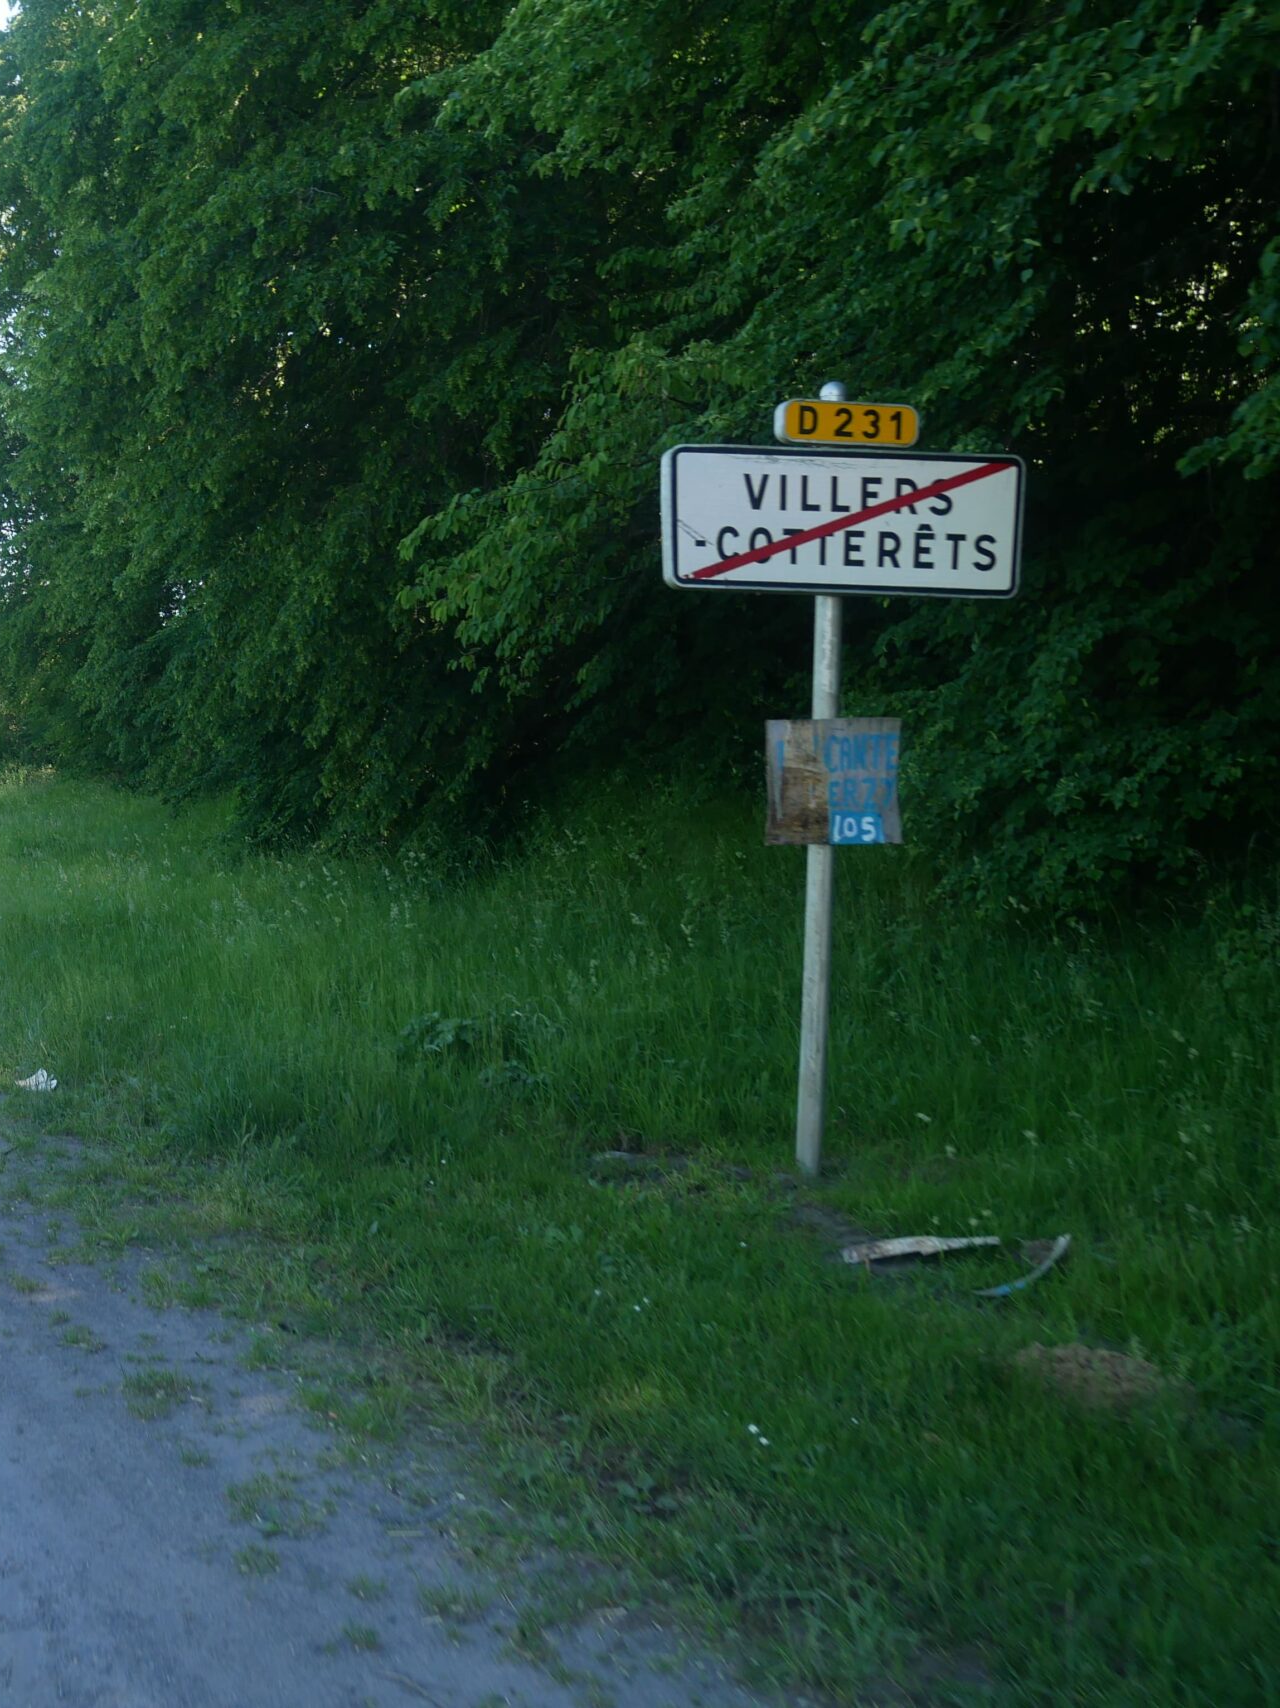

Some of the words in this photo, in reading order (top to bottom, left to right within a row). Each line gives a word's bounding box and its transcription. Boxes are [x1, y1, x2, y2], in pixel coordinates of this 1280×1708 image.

[799, 405, 818, 435] D
[833, 407, 904, 440] 231
[743, 473, 954, 516] VILLERS
[695, 523, 998, 571] -COTTERÊTS
